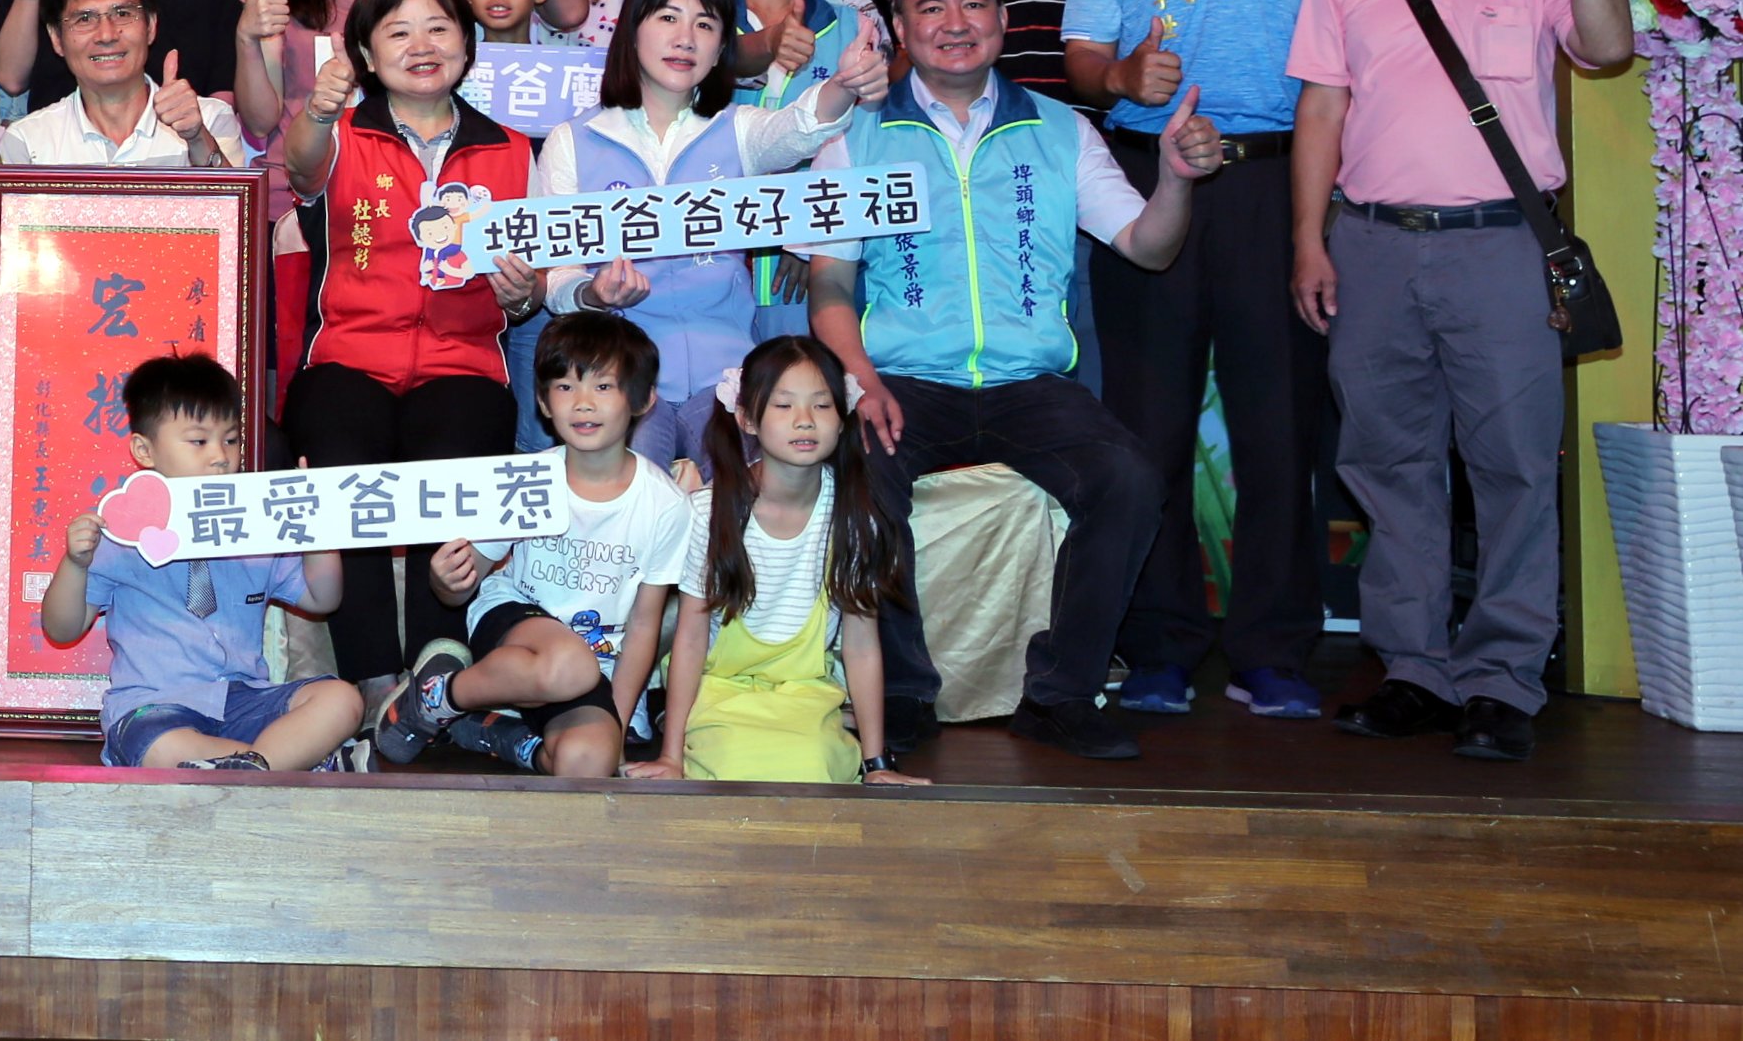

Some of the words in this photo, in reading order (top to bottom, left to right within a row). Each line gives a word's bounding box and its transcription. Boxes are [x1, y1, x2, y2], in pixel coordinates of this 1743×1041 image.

[375, 173, 394, 218] 鄉長
[485, 172, 917, 261] 埤頭爸爸好幸福
[1013, 164, 1037, 317] 埤頭鄉民代表會
[188, 462, 553, 546] 最愛爸比惹
[531, 560, 624, 594] LIBERTY
[568, 558, 590, 570] OF
